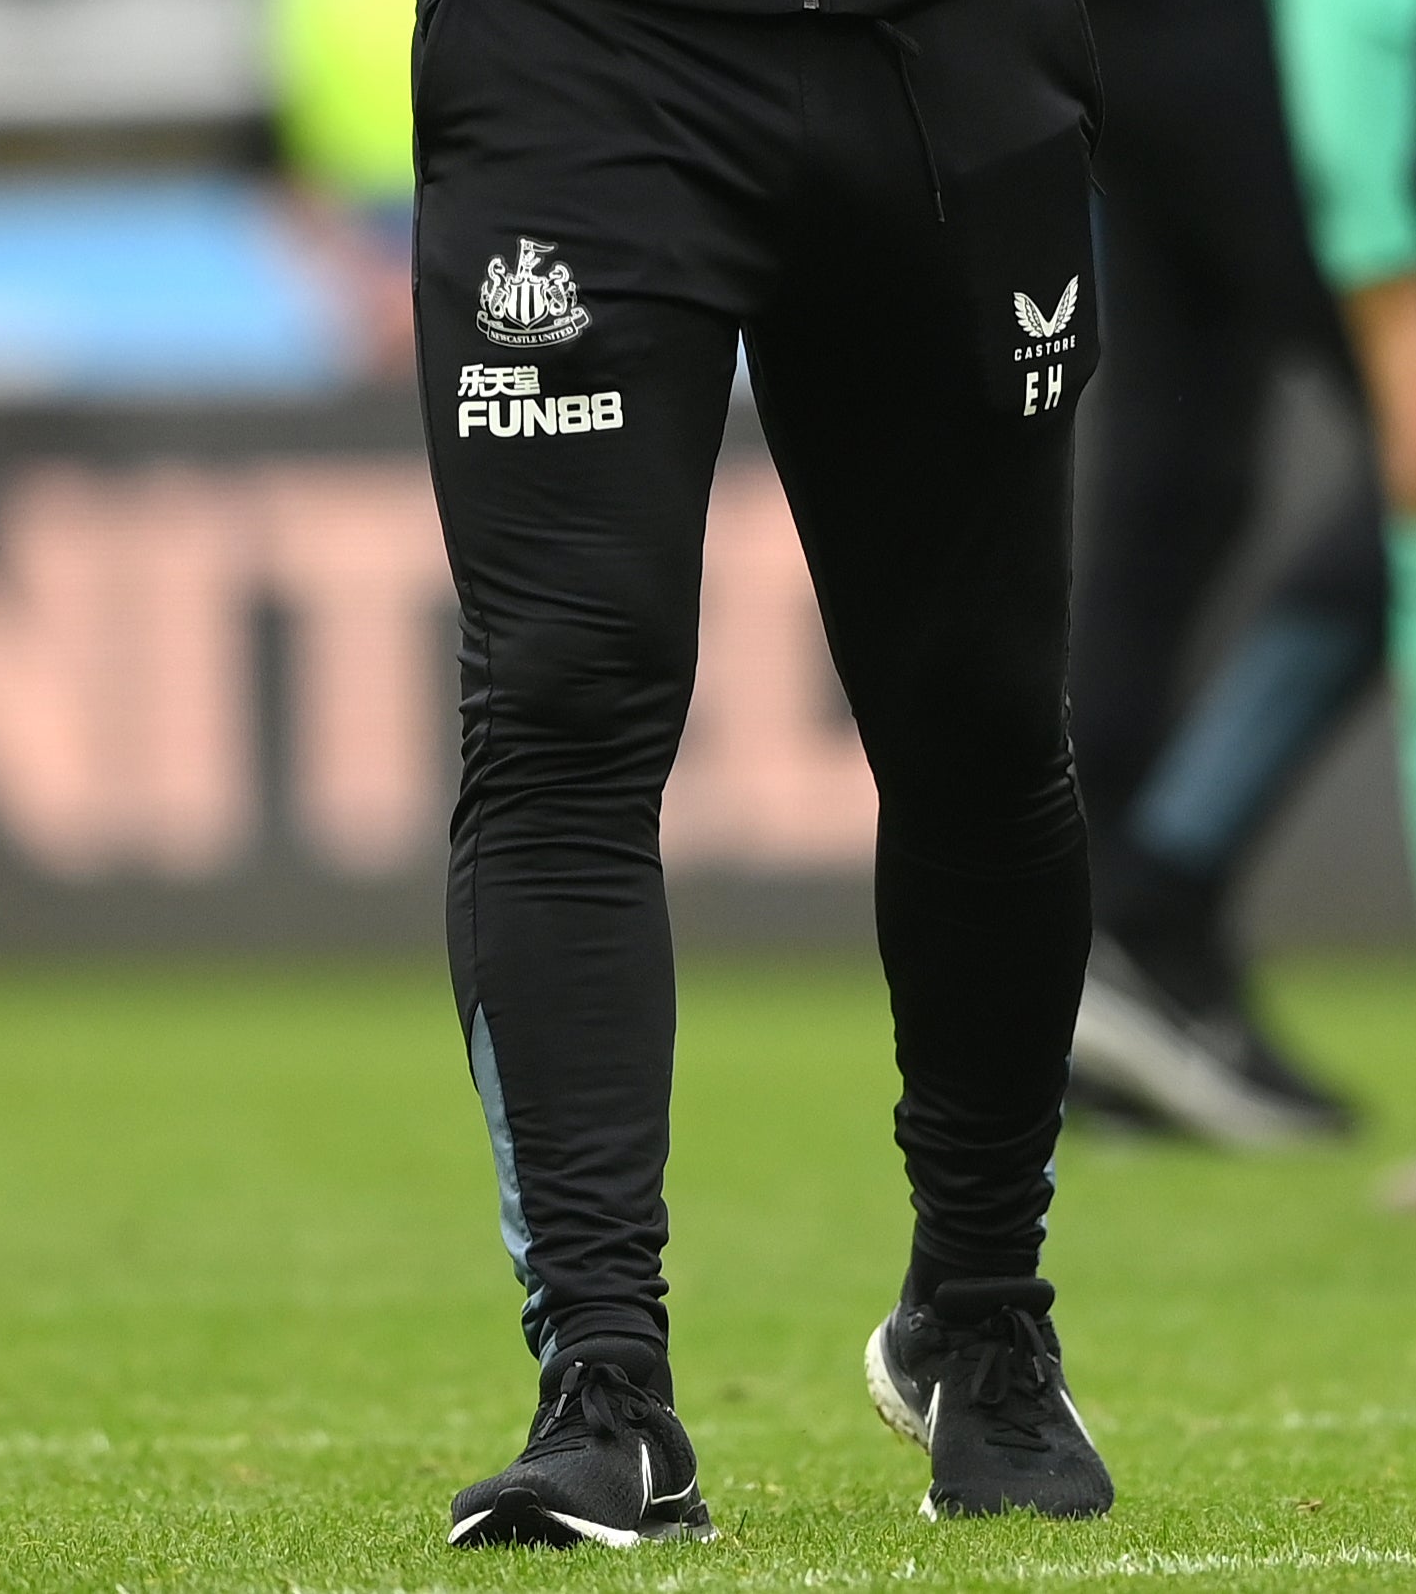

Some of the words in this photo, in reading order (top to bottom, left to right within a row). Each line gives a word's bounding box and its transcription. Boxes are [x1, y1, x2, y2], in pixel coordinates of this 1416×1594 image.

[490, 331, 538, 344] NEWCASTLE
[537, 325, 574, 342] UNITED
[1014, 334, 1077, 362] CASTORE
[457, 363, 541, 398] 乐天堂
[458, 391, 625, 439] FUN88
